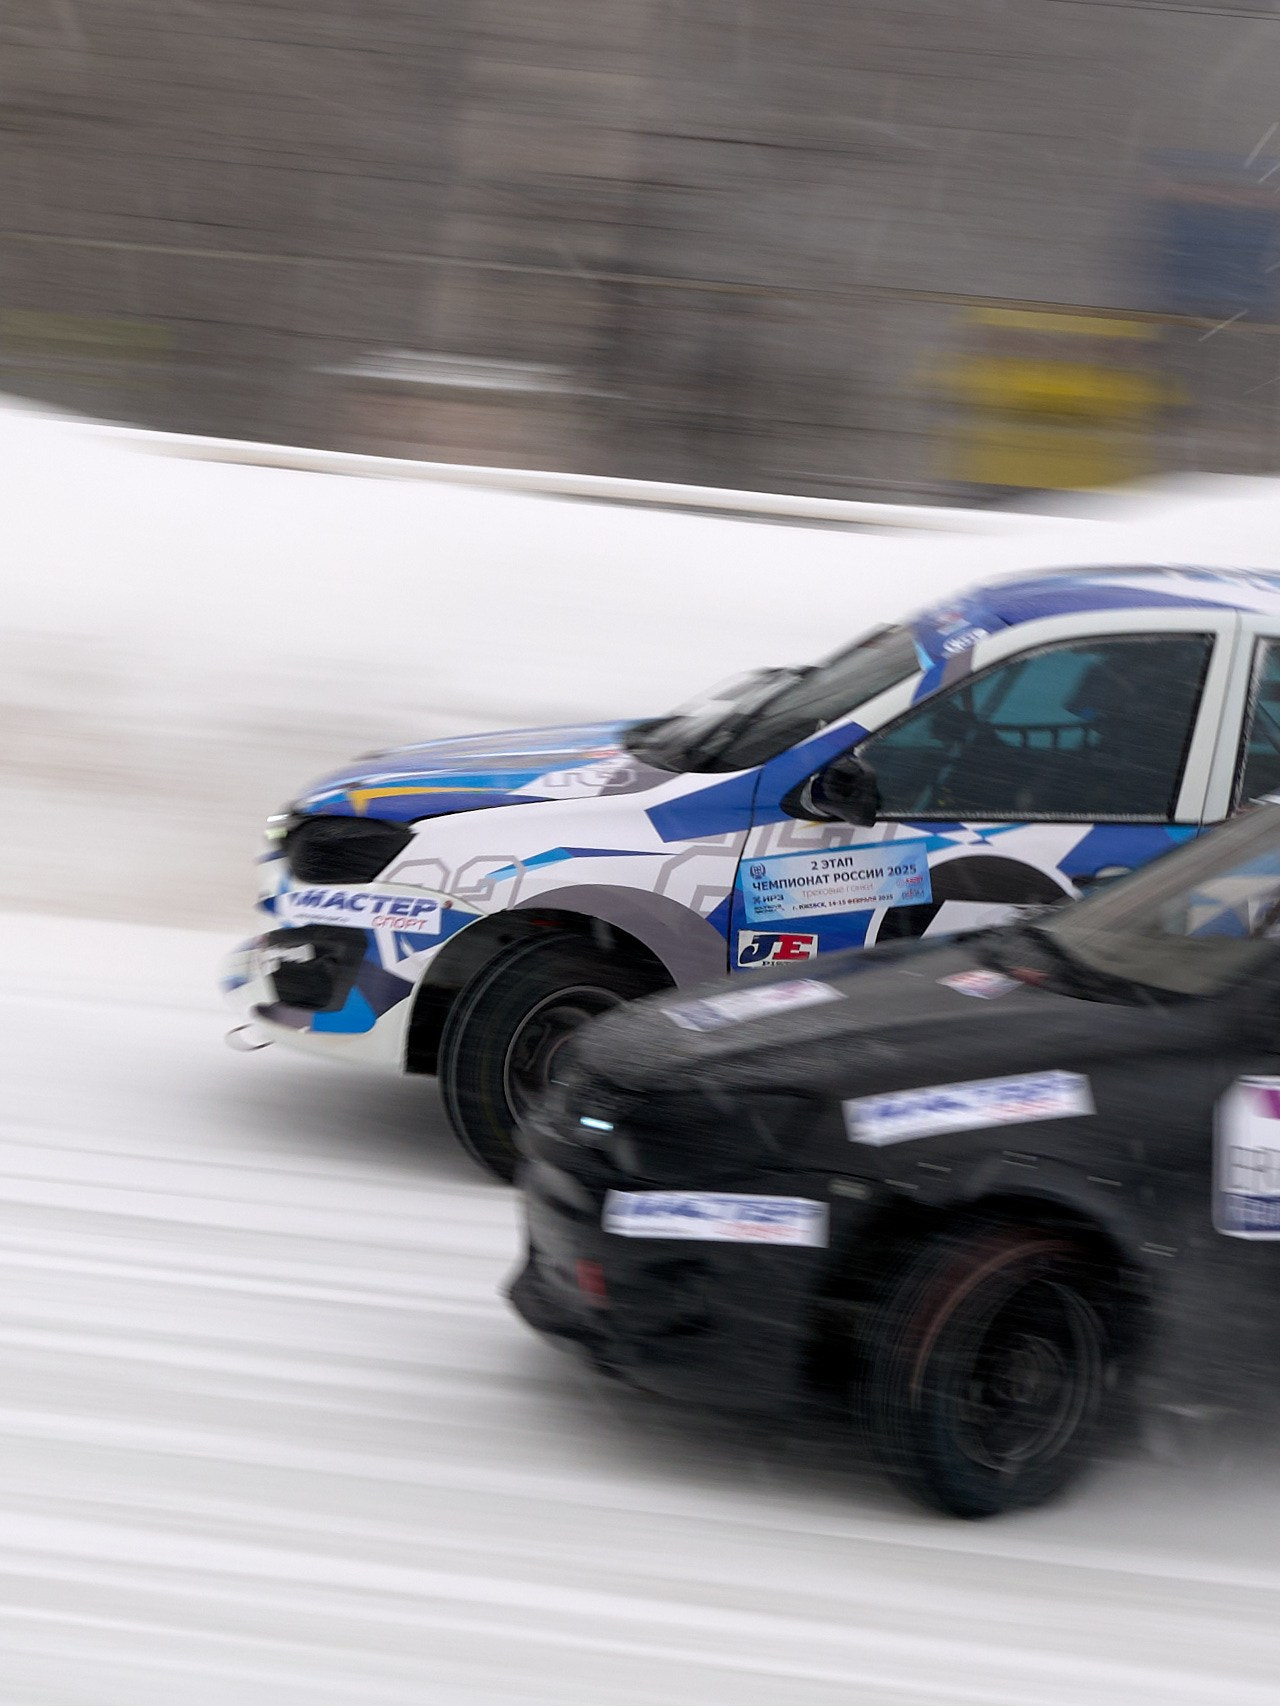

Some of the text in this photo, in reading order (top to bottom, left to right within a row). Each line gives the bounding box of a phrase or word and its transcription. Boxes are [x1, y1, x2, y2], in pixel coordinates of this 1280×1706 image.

[752, 874, 833, 892] ЧЕМПИОНАТ
[834, 868, 884, 884] РОССИИ
[887, 864, 917, 877] 2025
[811, 857, 853, 871] 2 ЭТАП
[294, 888, 438, 917] МАСТЕР
[740, 934, 814, 965] JE
